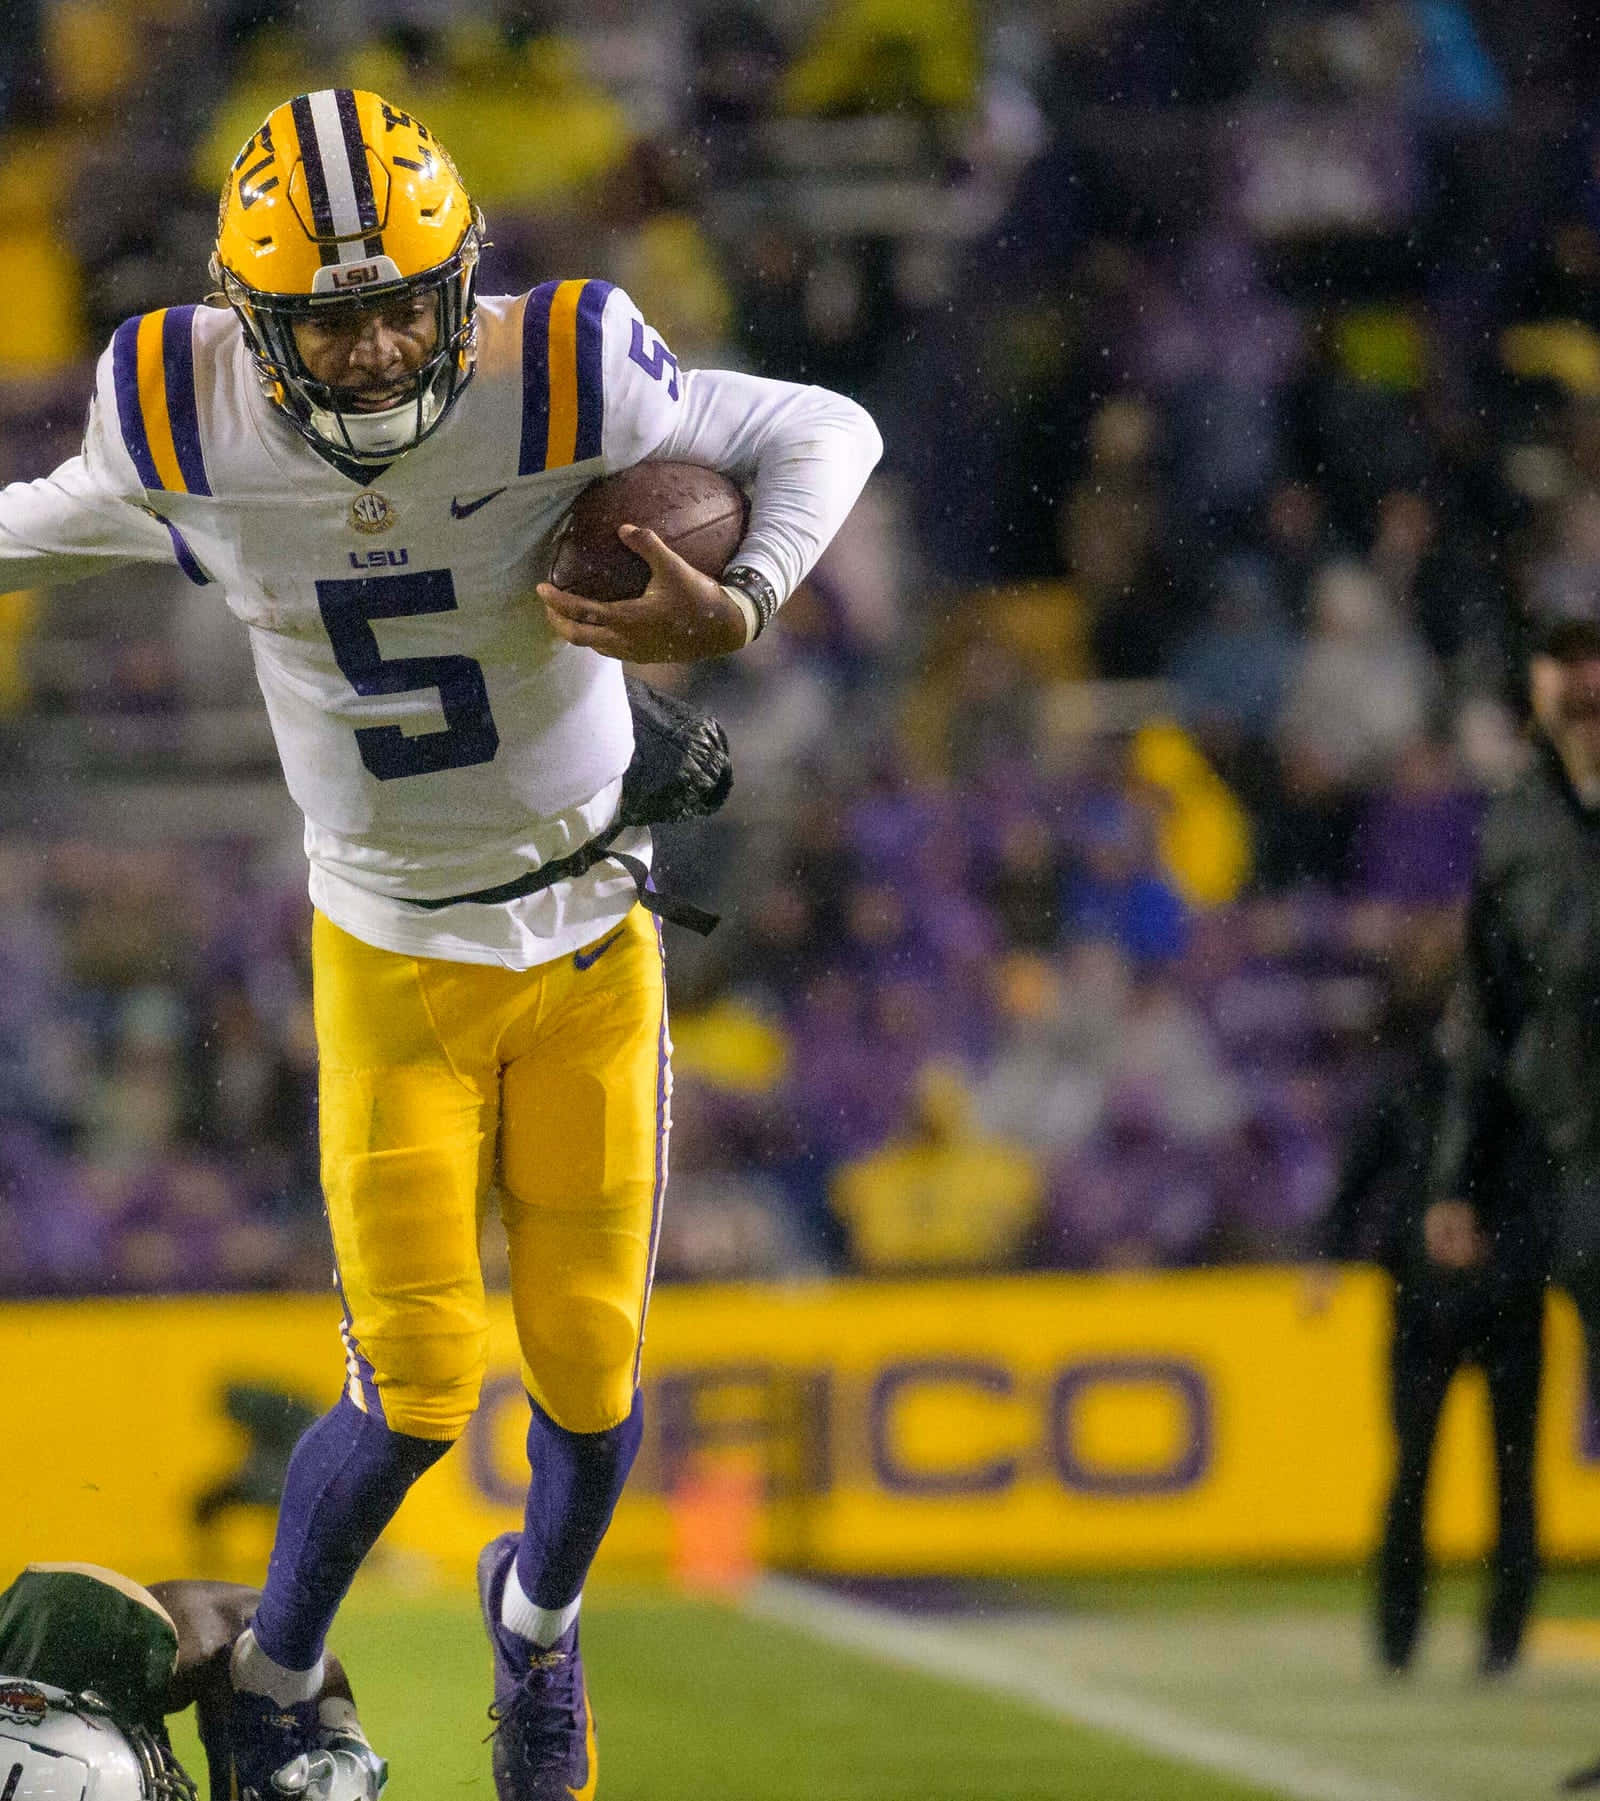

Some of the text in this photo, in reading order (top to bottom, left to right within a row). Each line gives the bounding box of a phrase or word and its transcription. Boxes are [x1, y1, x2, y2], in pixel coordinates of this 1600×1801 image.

[332, 265, 379, 288] LSU
[628, 318, 679, 402] 5
[353, 494, 387, 523] SEC
[349, 548, 409, 569] LSU
[315, 568, 499, 781] 5
